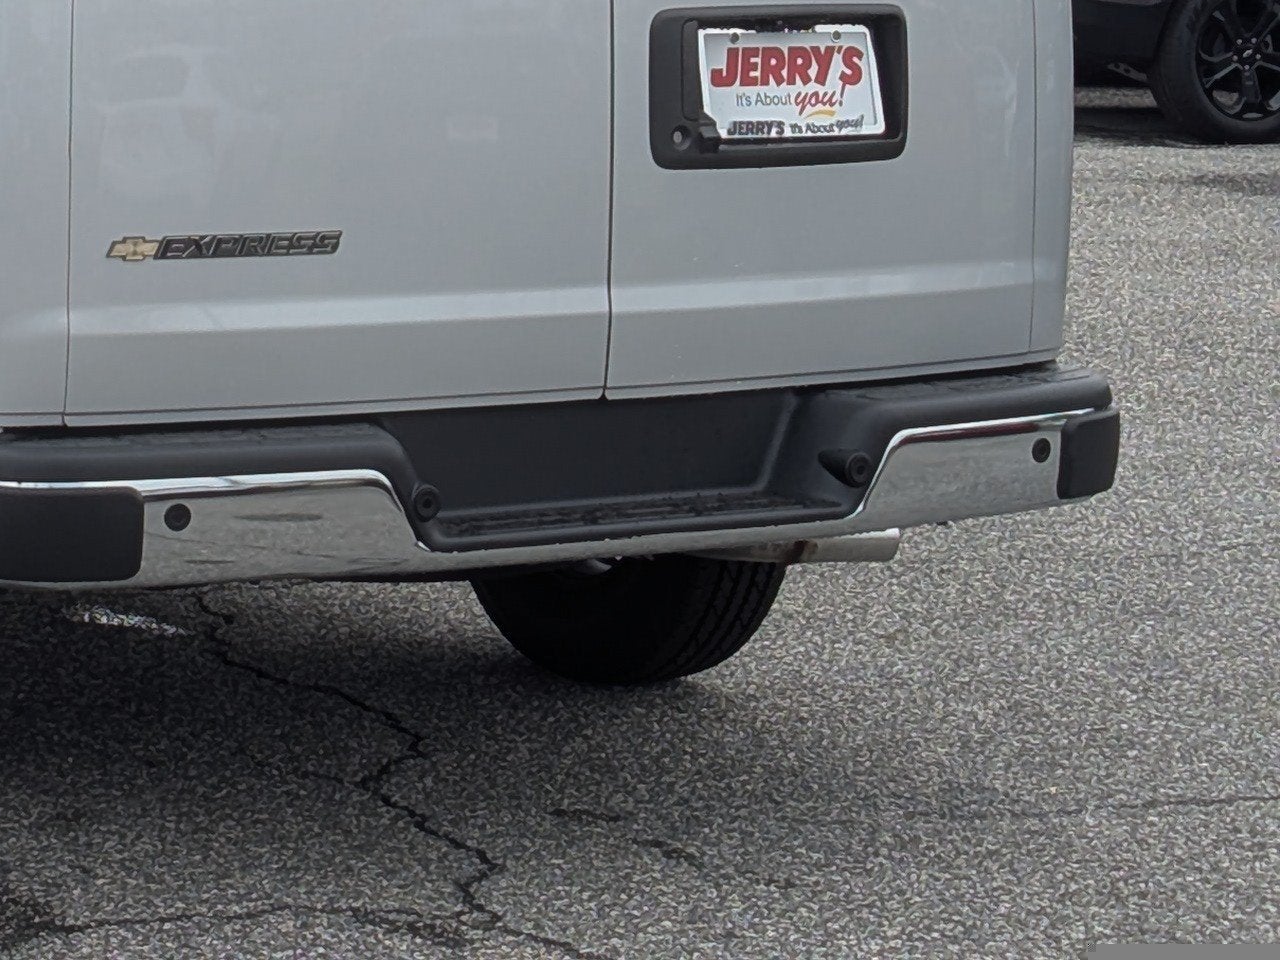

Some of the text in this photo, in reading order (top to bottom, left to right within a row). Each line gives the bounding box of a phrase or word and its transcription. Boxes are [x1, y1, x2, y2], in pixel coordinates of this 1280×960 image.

[710, 45, 864, 87] JERRY'S
[736, 83, 846, 116] It's About you!
[727, 120, 785, 136] JERRY'S
[804, 122, 835, 135] About
[154, 230, 342, 260] EXPRESS
